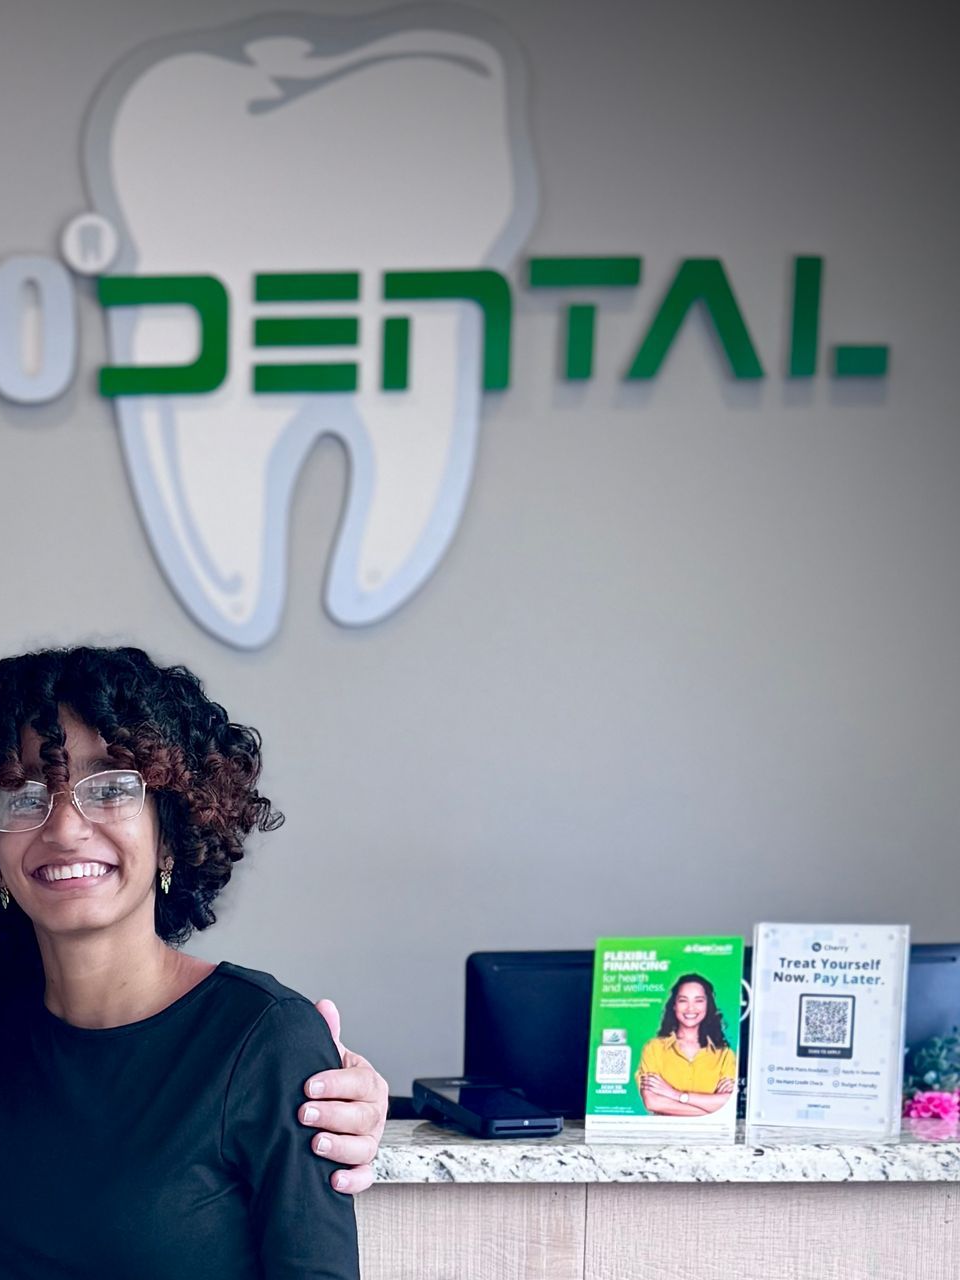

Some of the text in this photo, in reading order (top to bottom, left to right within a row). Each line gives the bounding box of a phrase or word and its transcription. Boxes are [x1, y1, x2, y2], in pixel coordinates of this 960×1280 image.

[97, 255, 890, 398] DENTAL
[603, 950, 657, 961] FLEXIBLE
[779, 957, 882, 970] Treat Yourself
[603, 973, 649, 983] for health
[773, 971, 885, 987] Now. Pay Later.
[602, 983, 621, 992] and
